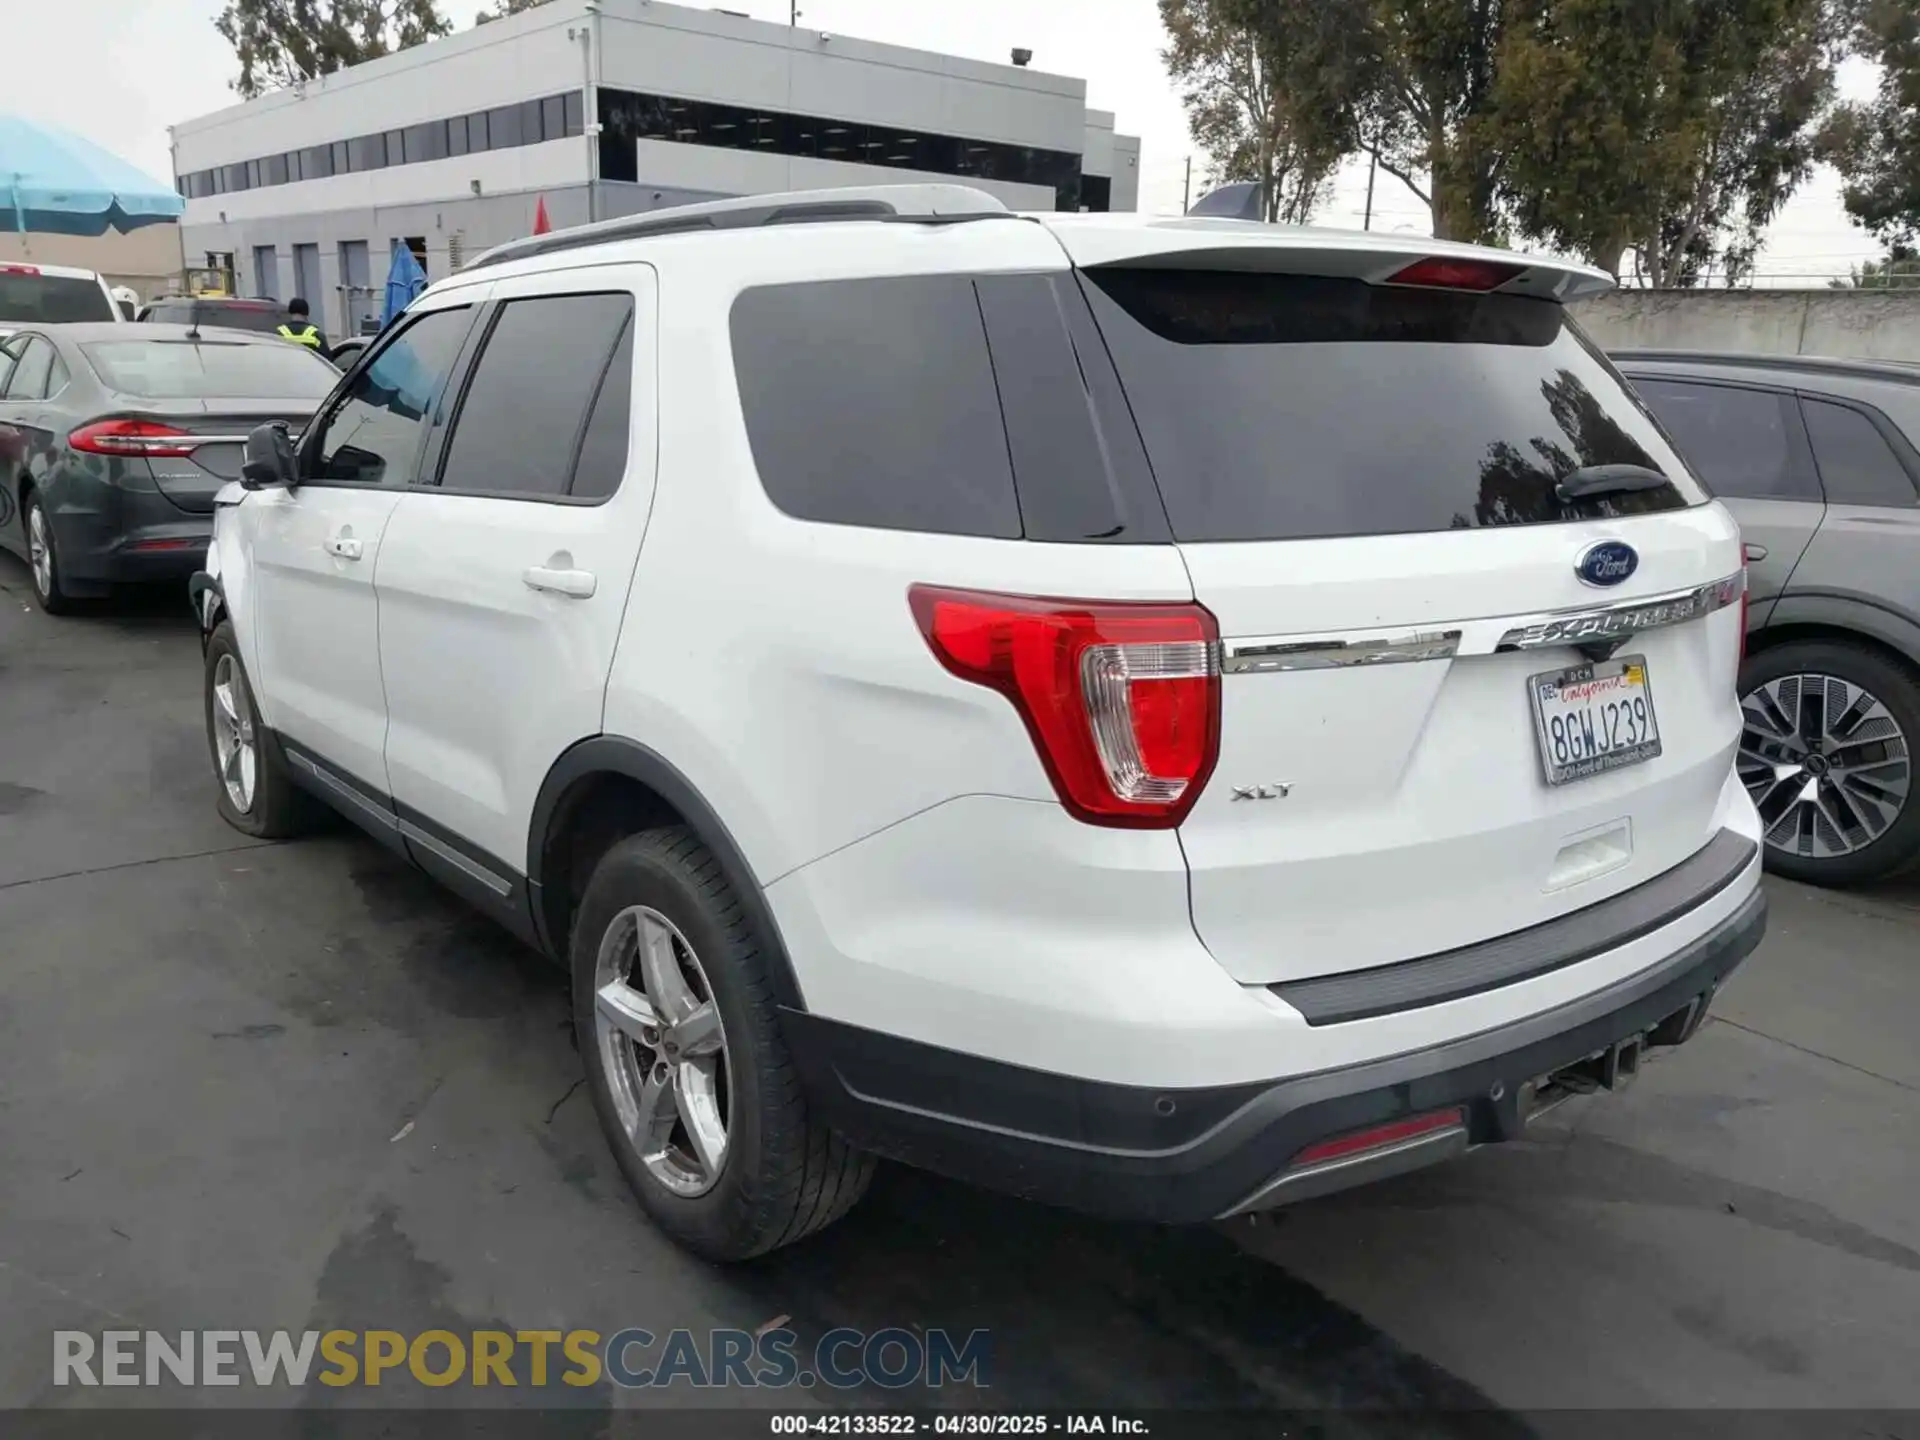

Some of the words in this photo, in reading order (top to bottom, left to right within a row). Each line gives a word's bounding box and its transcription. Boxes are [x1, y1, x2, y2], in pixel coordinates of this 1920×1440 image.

[1594, 549, 1630, 578] Ford
[1518, 599, 1696, 650] EXPLORER
[1560, 675, 1627, 704] California
[1551, 697, 1647, 763] 8GWJ239
[1228, 780, 1297, 803] XLT
